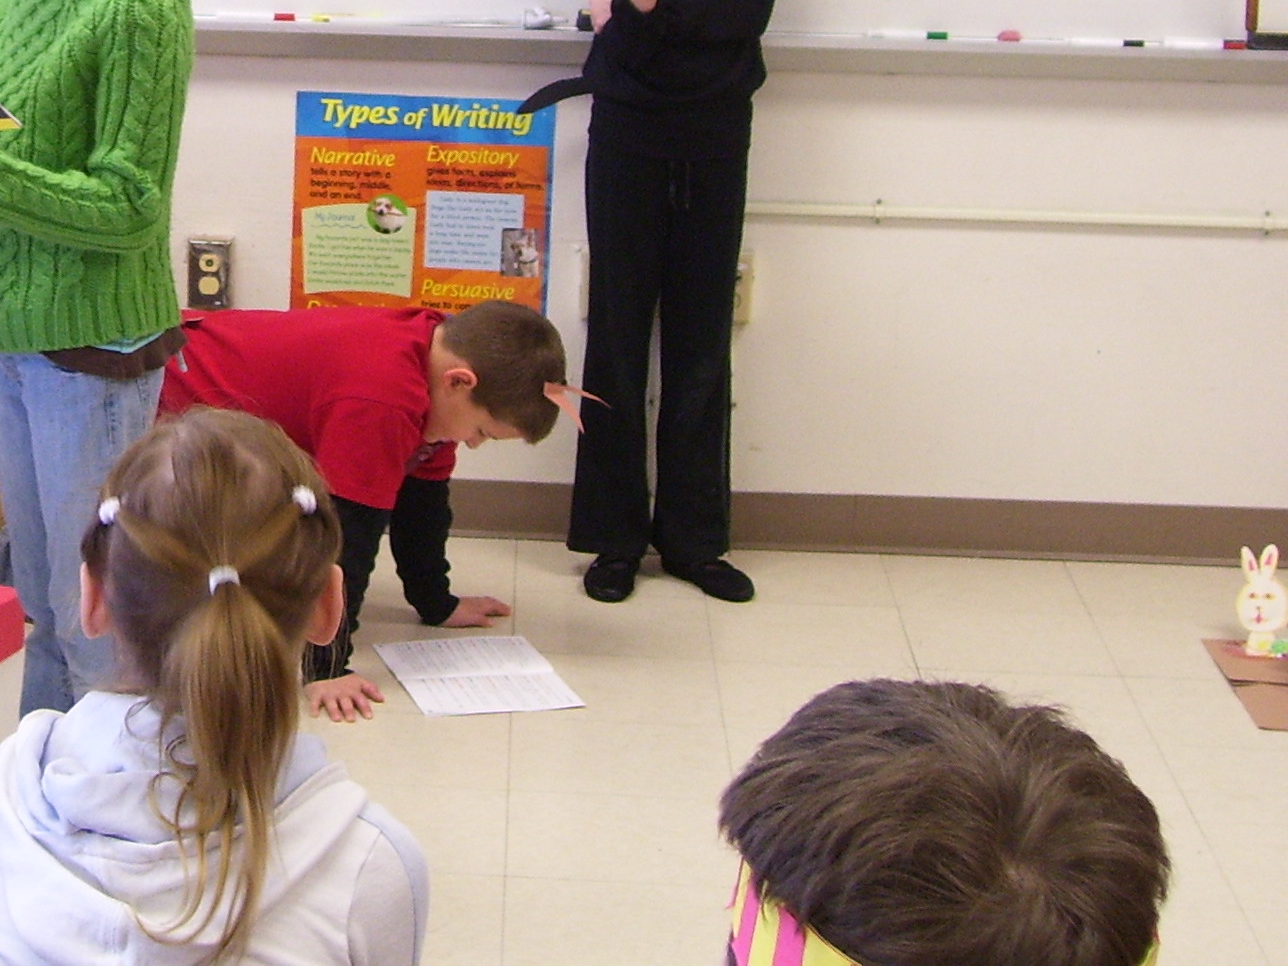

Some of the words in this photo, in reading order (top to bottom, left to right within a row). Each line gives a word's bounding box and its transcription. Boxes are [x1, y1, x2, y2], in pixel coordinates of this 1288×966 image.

[321, 97, 400, 129] Types
[403, 107, 428, 130] of
[431, 103, 534, 136] Writing
[310, 147, 396, 167] Narrative
[426, 145, 519, 169] Expository
[339, 169, 361, 179] story
[310, 190, 328, 199] and
[330, 191, 342, 199] an
[420, 279, 516, 301] Persuasive
